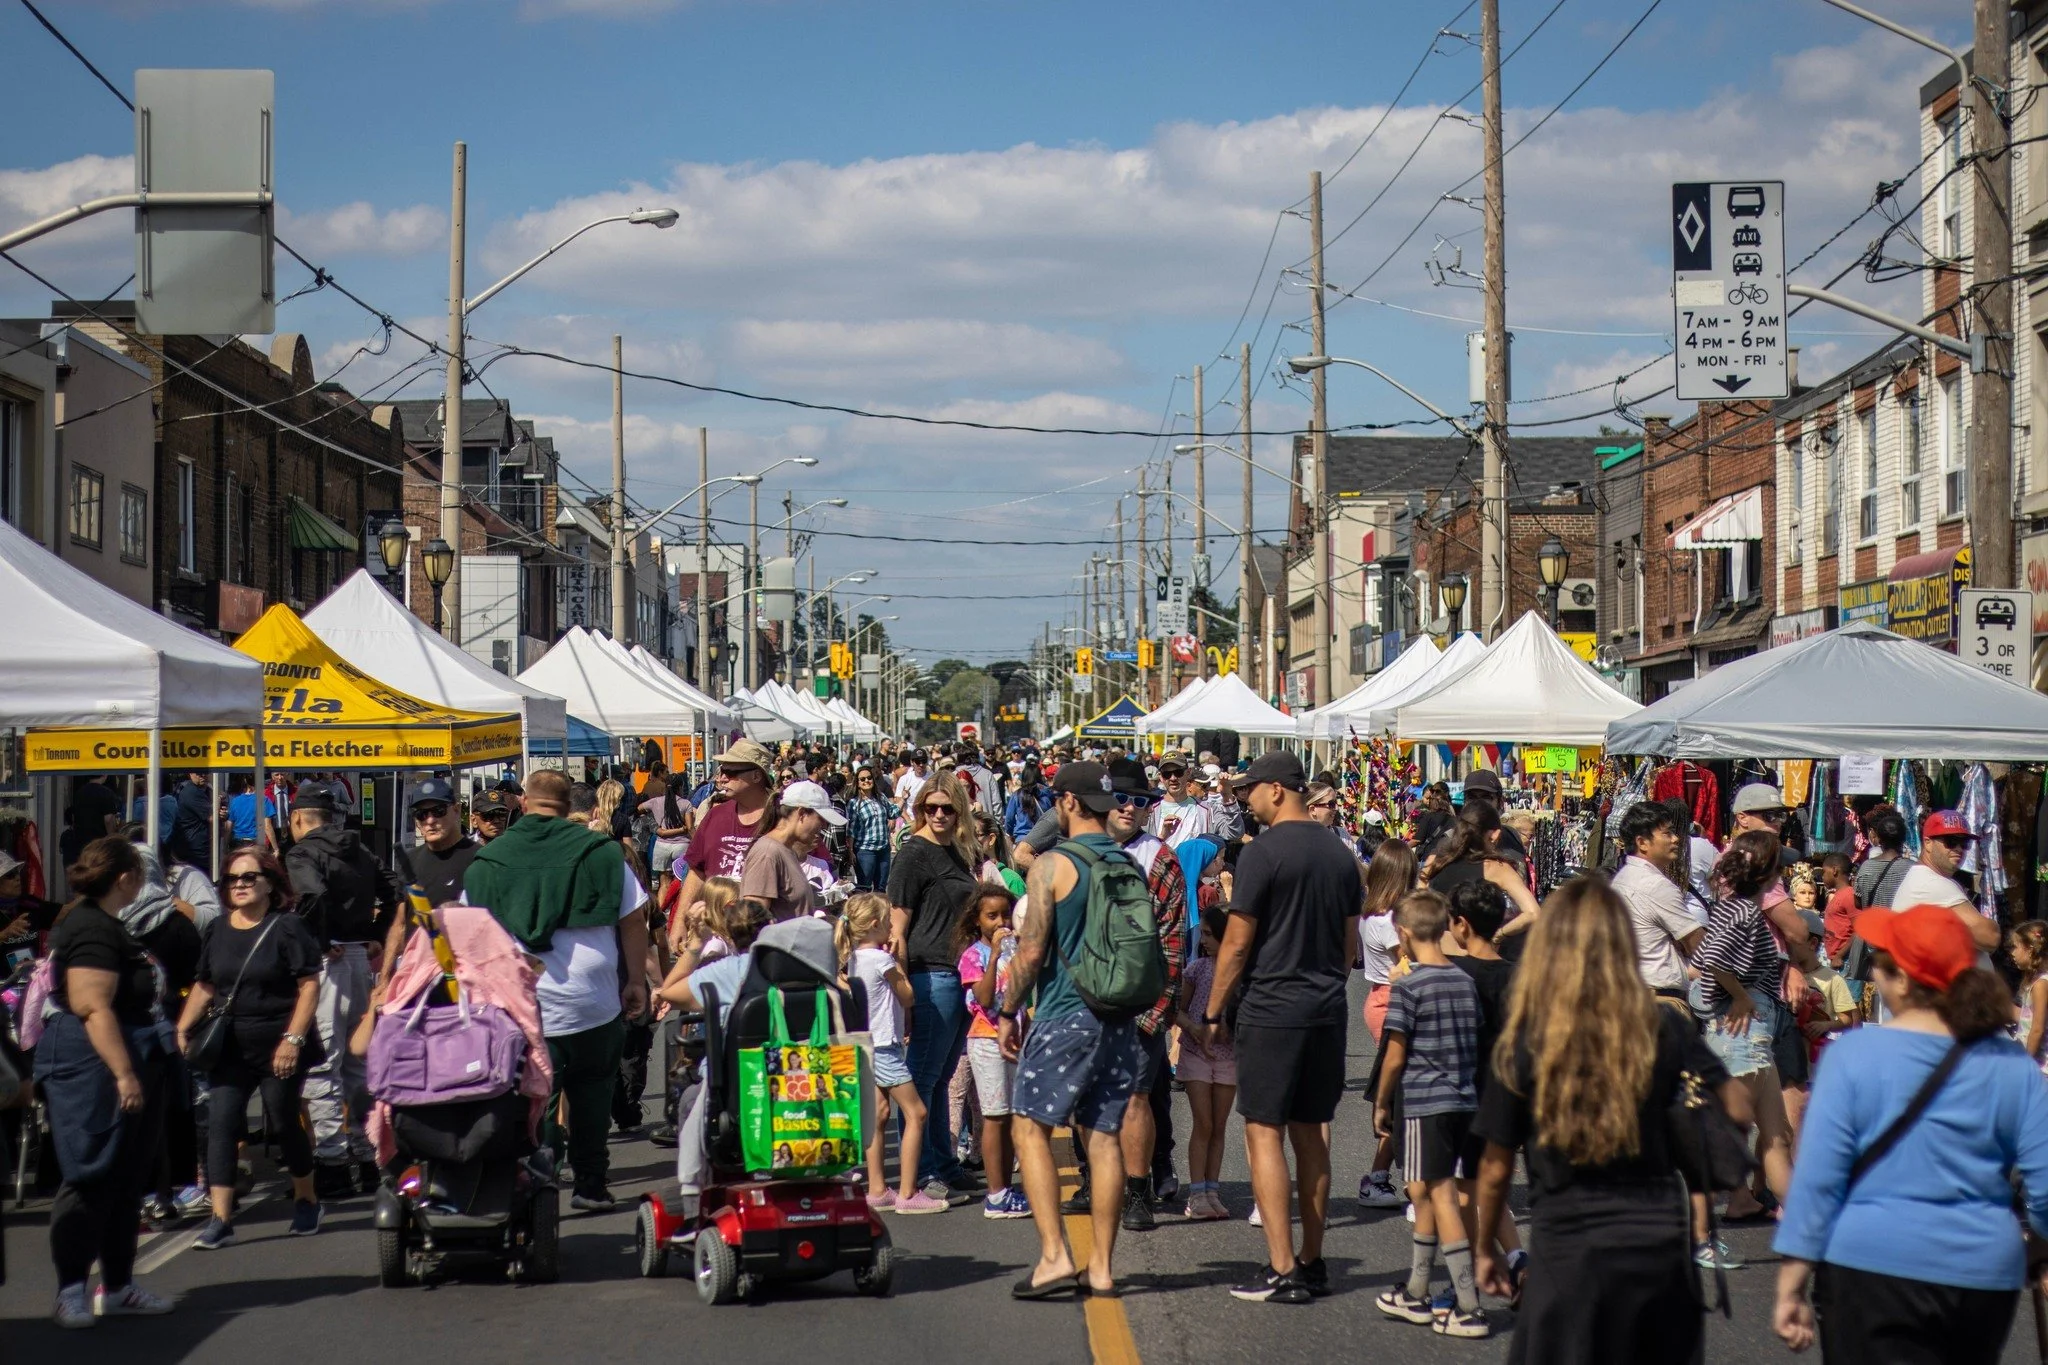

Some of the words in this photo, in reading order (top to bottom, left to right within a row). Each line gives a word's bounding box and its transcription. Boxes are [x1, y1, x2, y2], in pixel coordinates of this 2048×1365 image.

[1736, 232, 1757, 242] TAXI
[1697, 355, 1728, 366] MON
[1744, 354, 1766, 366] FRI
[1894, 581, 1926, 613] DOLLAR
[1927, 576, 1949, 610] STORE
[1926, 613, 1950, 637] OUTLET
[1976, 636, 1989, 656] 3
[1997, 645, 2015, 657] OR
[1977, 663, 2013, 676] ORE
[264, 688, 344, 713] ula
[264, 713, 340, 724] her
[46, 748, 80, 760] TORONTO
[93, 740, 211, 760] Counillor
[290, 741, 383, 757] Fletcher
[409, 745, 445, 757] TORONTO
[1531, 755, 1547, 769] $10
[1555, 754, 1567, 768] $5
[783, 1110, 807, 1119] food
[773, 1116, 820, 1132] Basics
